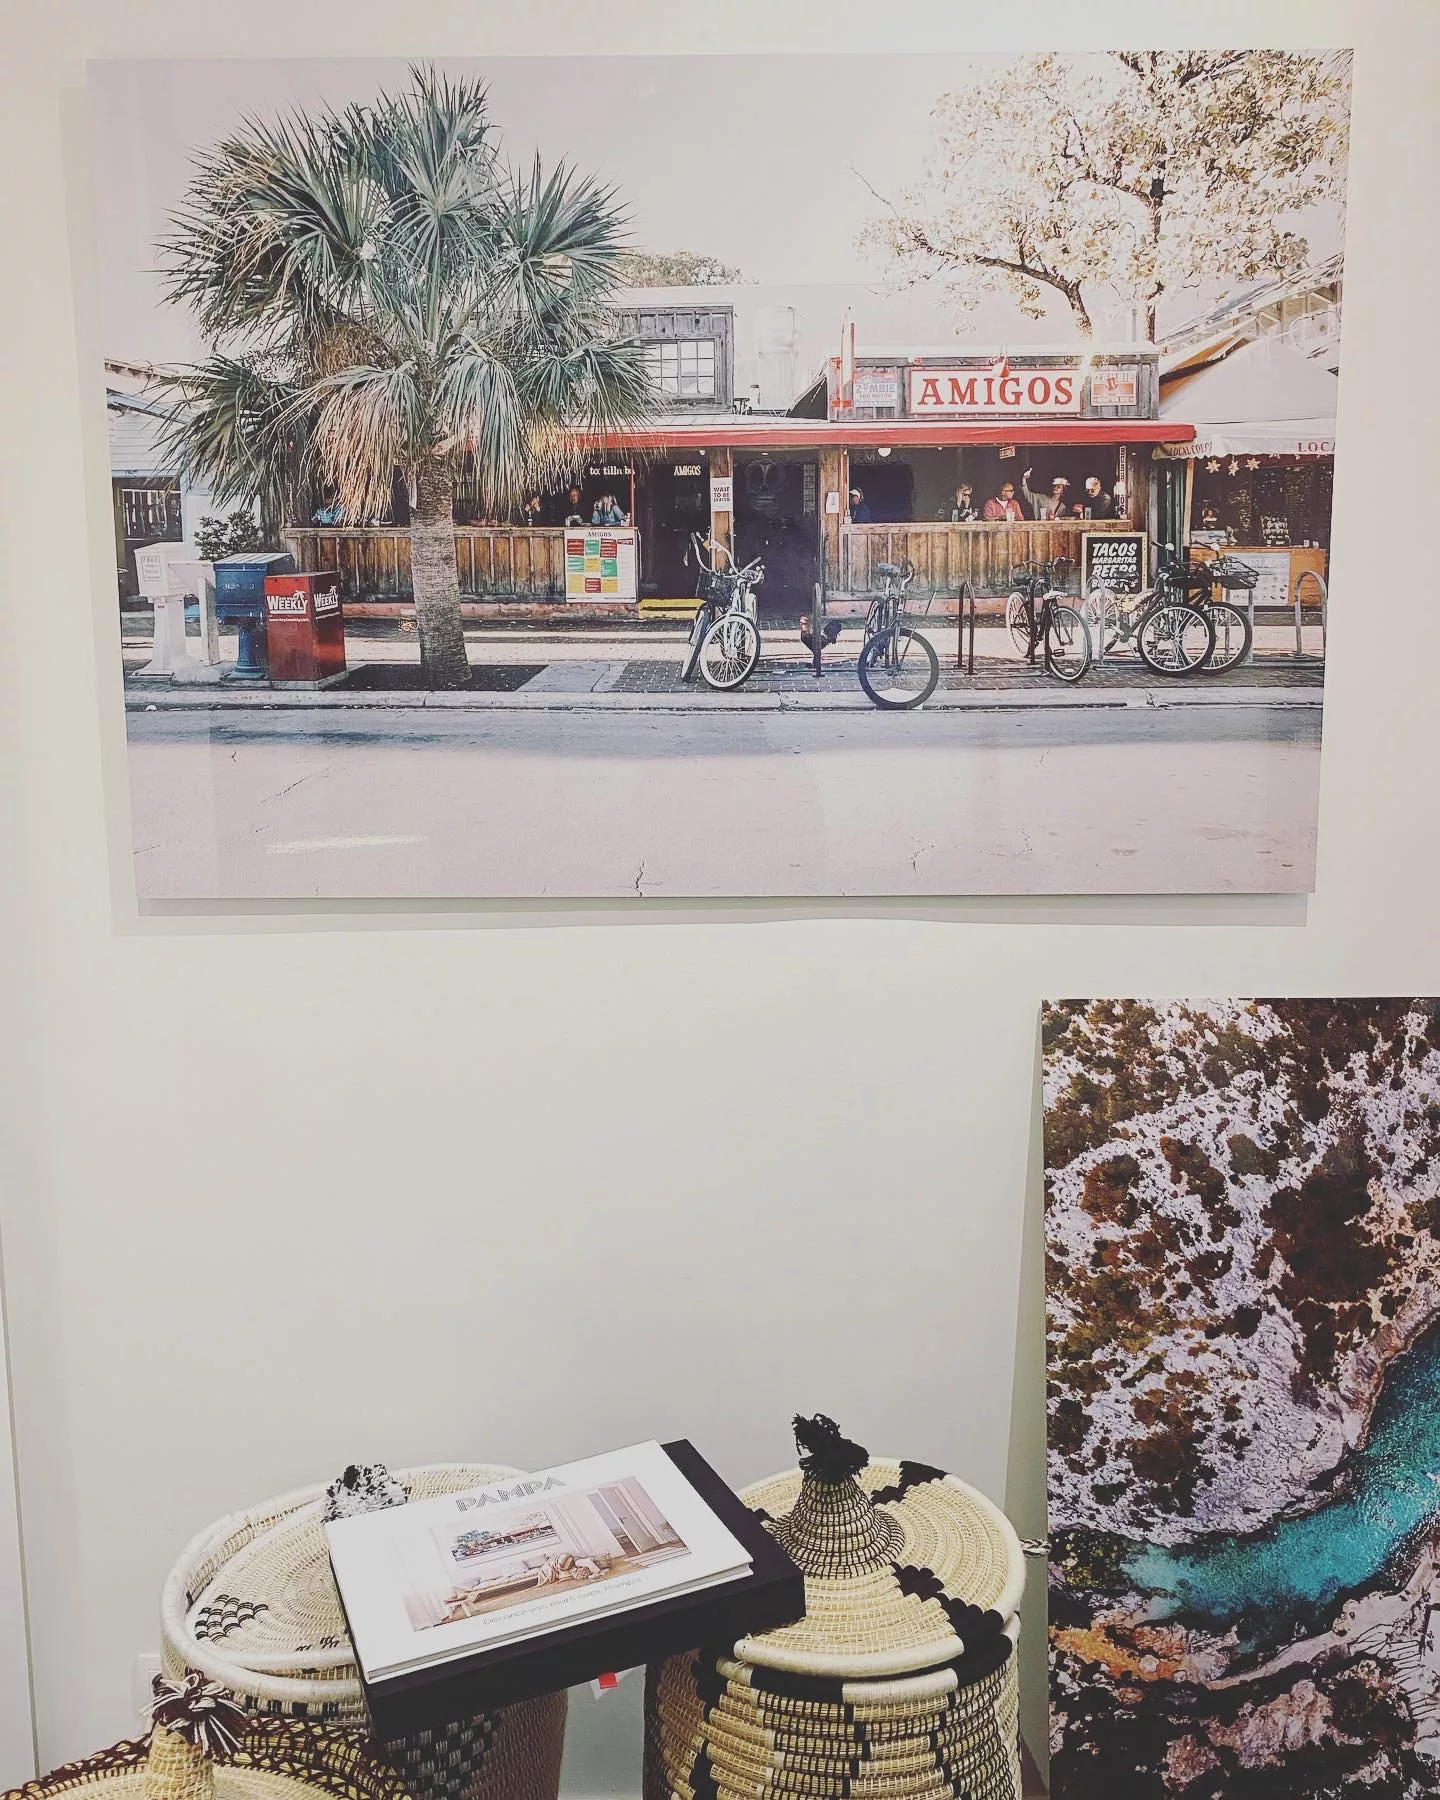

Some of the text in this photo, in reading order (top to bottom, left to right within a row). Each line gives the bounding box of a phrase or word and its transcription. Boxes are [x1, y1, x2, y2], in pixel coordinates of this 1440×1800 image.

[918, 376, 1073, 405] AMIGOS
[673, 465, 701, 476] AMIGOS
[1092, 542, 1138, 557] TACOS
[1091, 556, 1137, 564] MARGARITAS
[266, 595, 309, 611] WEEKLY
[314, 592, 339, 608] WEEKLY
[455, 1476, 568, 1512] PAMPA
